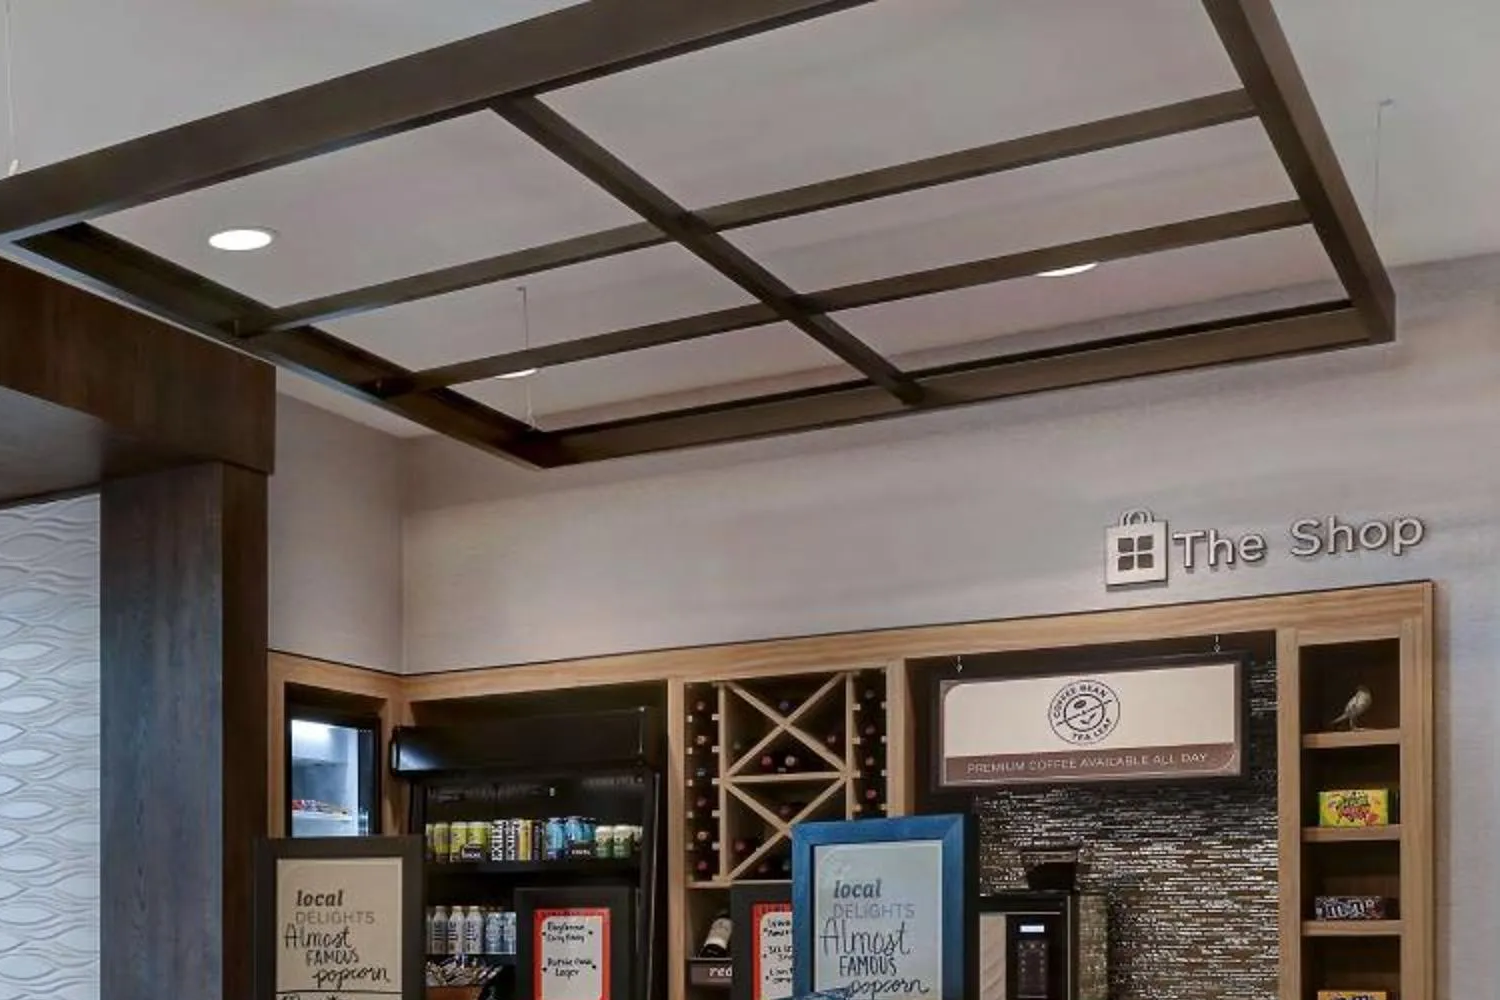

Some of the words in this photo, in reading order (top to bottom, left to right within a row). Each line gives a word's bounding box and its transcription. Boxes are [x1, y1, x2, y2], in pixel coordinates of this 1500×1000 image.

[1172, 529, 1267, 569] The
[1291, 516, 1425, 557] Shop
[967, 761, 1025, 774] PREMIUM
[1029, 759, 1077, 772] COFFEE
[1079, 757, 1149, 770] AVAILABLE
[1153, 755, 1176, 765] ALL
[1181, 752, 1208, 764] DAY
[296, 888, 344, 907] local
[834, 879, 882, 899] local
[295, 911, 375, 925] DELIGHTS
[833, 903, 915, 919] DELIGHTS
[284, 922, 352, 949] Almost
[820, 917, 912, 957] Almost
[306, 946, 360, 967] FAMOUS
[839, 954, 898, 977] FAMOUS
[311, 967, 391, 989] popcorn
[849, 977, 931, 1000] popcorn
